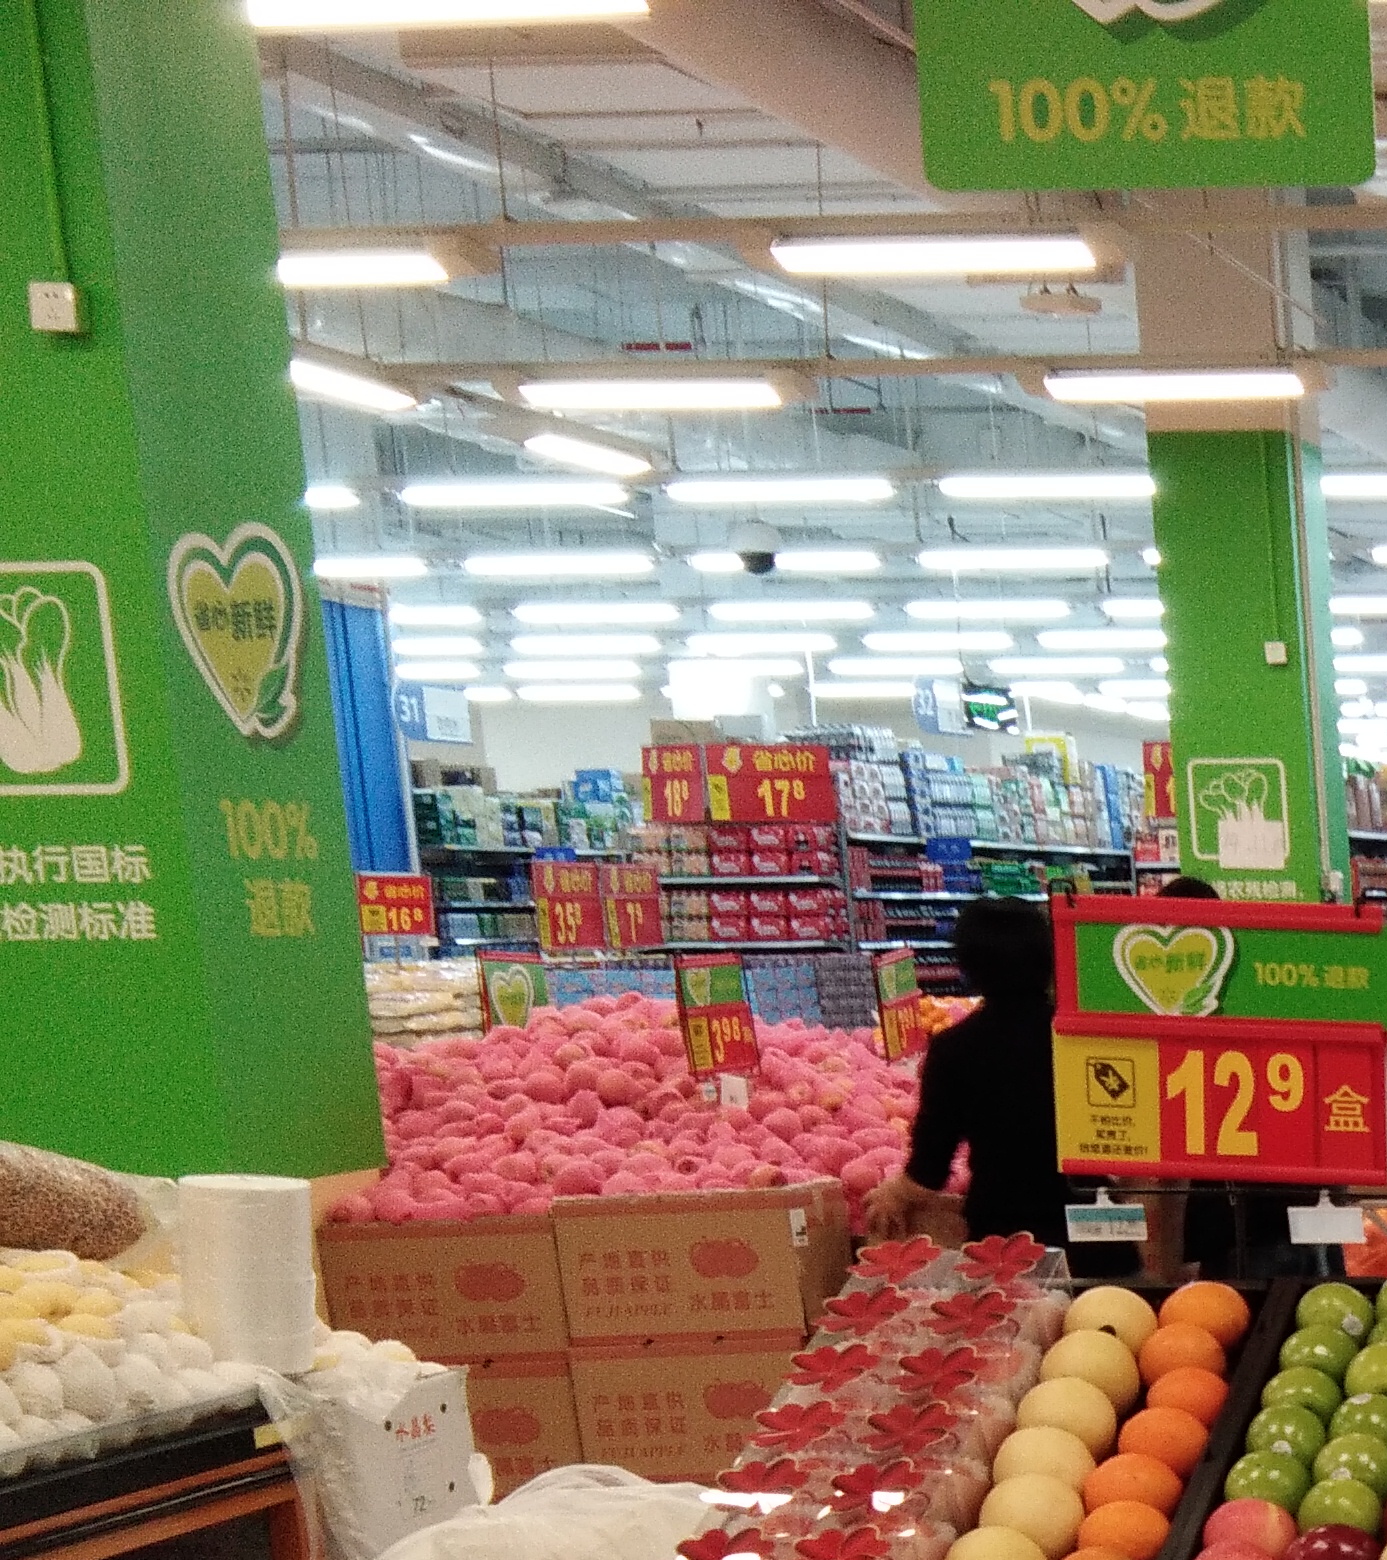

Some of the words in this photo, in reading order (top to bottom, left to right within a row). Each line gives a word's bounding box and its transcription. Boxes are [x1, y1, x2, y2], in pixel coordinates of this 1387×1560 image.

[989, 76, 1168, 143] 100%
[1180, 75, 1306, 140] 退款
[399, 696, 422, 723] 31
[219, 798, 320, 860] 100%
[0, 844, 151, 884] 执行国标
[1, 901, 158, 941] 检测标准
[243, 876, 317, 938] 退款
[1254, 961, 1320, 988] 100%
[1323, 1084, 1371, 1133] 盒
